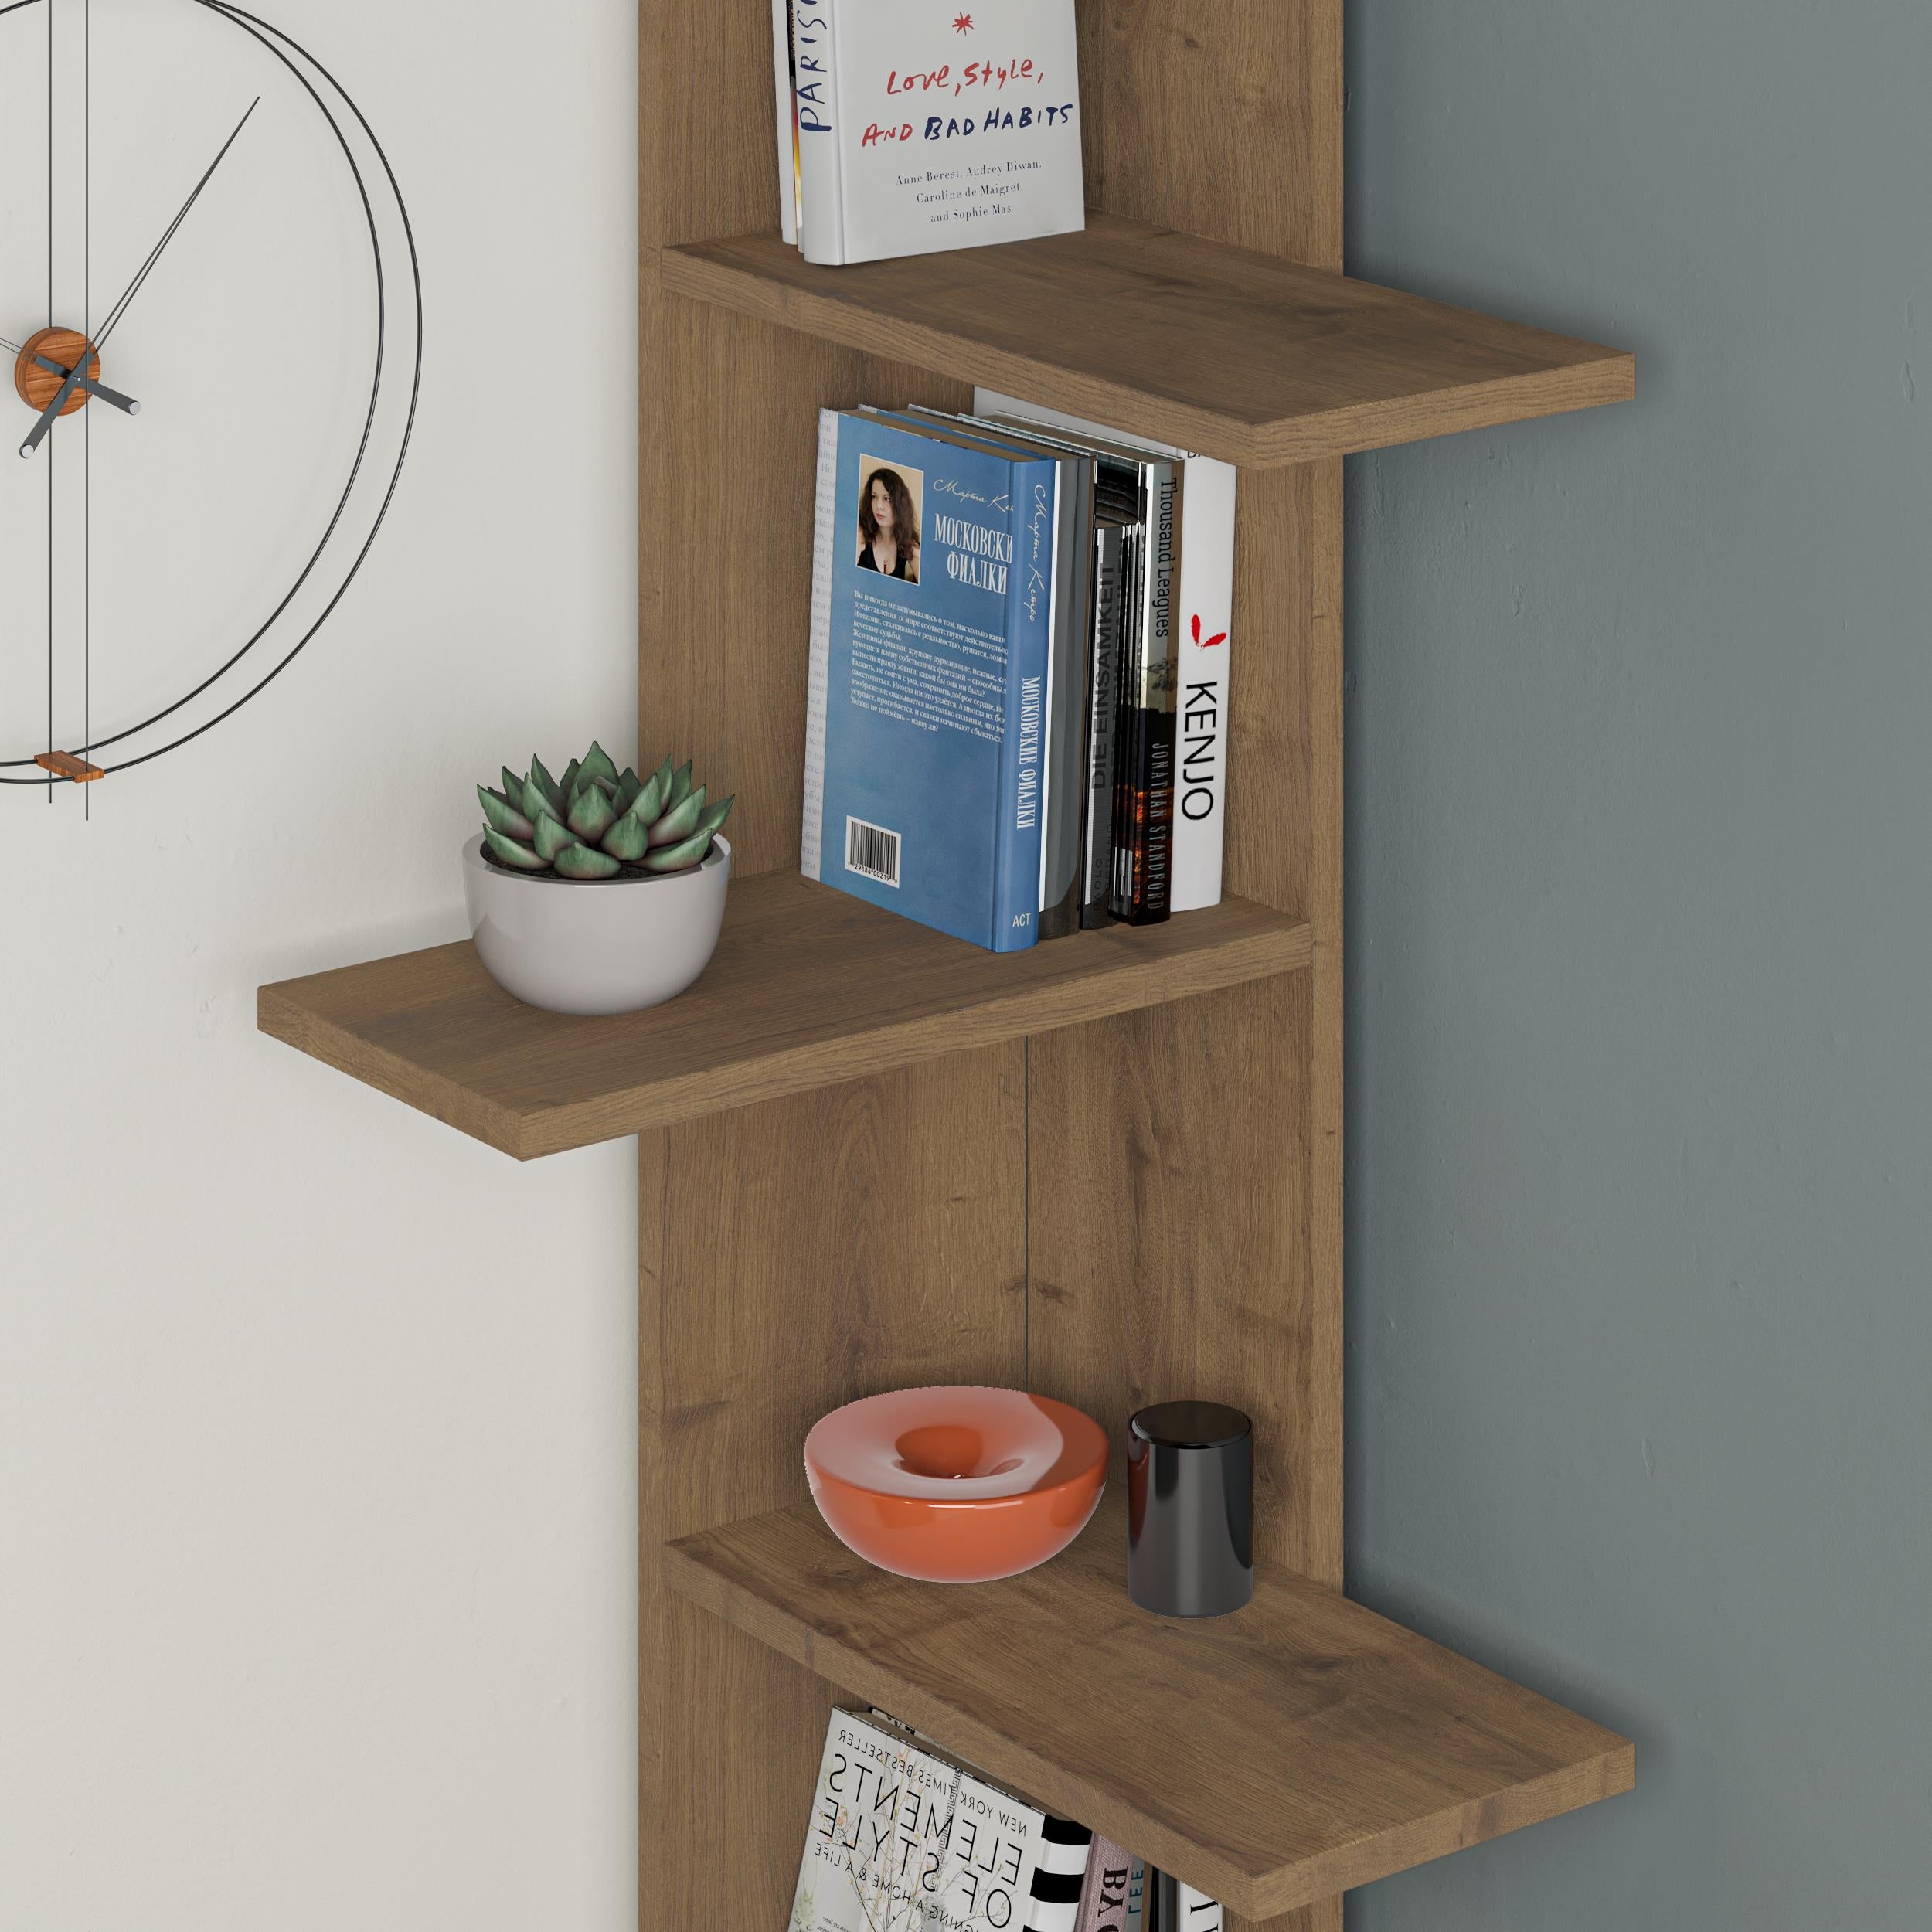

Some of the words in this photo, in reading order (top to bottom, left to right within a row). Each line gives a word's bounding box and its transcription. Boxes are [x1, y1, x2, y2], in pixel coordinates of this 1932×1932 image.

[862, 124, 913, 147] AND
[924, 117, 975, 141] BAD
[984, 104, 1073, 132] HABITS
[896, 175, 923, 185] Anne
[966, 165, 1002, 176] Audrey
[917, 189, 961, 203] Caroline
[965, 187, 977, 197] de
[930, 210, 949, 223] and
[953, 206, 988, 222] Sophie
[992, 204, 1012, 215] Mas
[934, 512, 1012, 563] МОСКОВСКИ
[1158, 477, 1177, 563] Thousand
[947, 550, 1008, 594] ФИАЛКИ
[1152, 567, 1174, 638] Leagues
[1094, 563, 1114, 733] EINSAMKEIT
[1019, 676, 1040, 765] МОСКОВСКИЕ
[1182, 681, 1217, 820] KENJO
[1092, 743, 1107, 788] DIE
[1151, 743, 1168, 818] JONATHAN
[1016, 768, 1036, 829] ФИАЛКИ
[1147, 825, 1166, 910] STANDFORD
